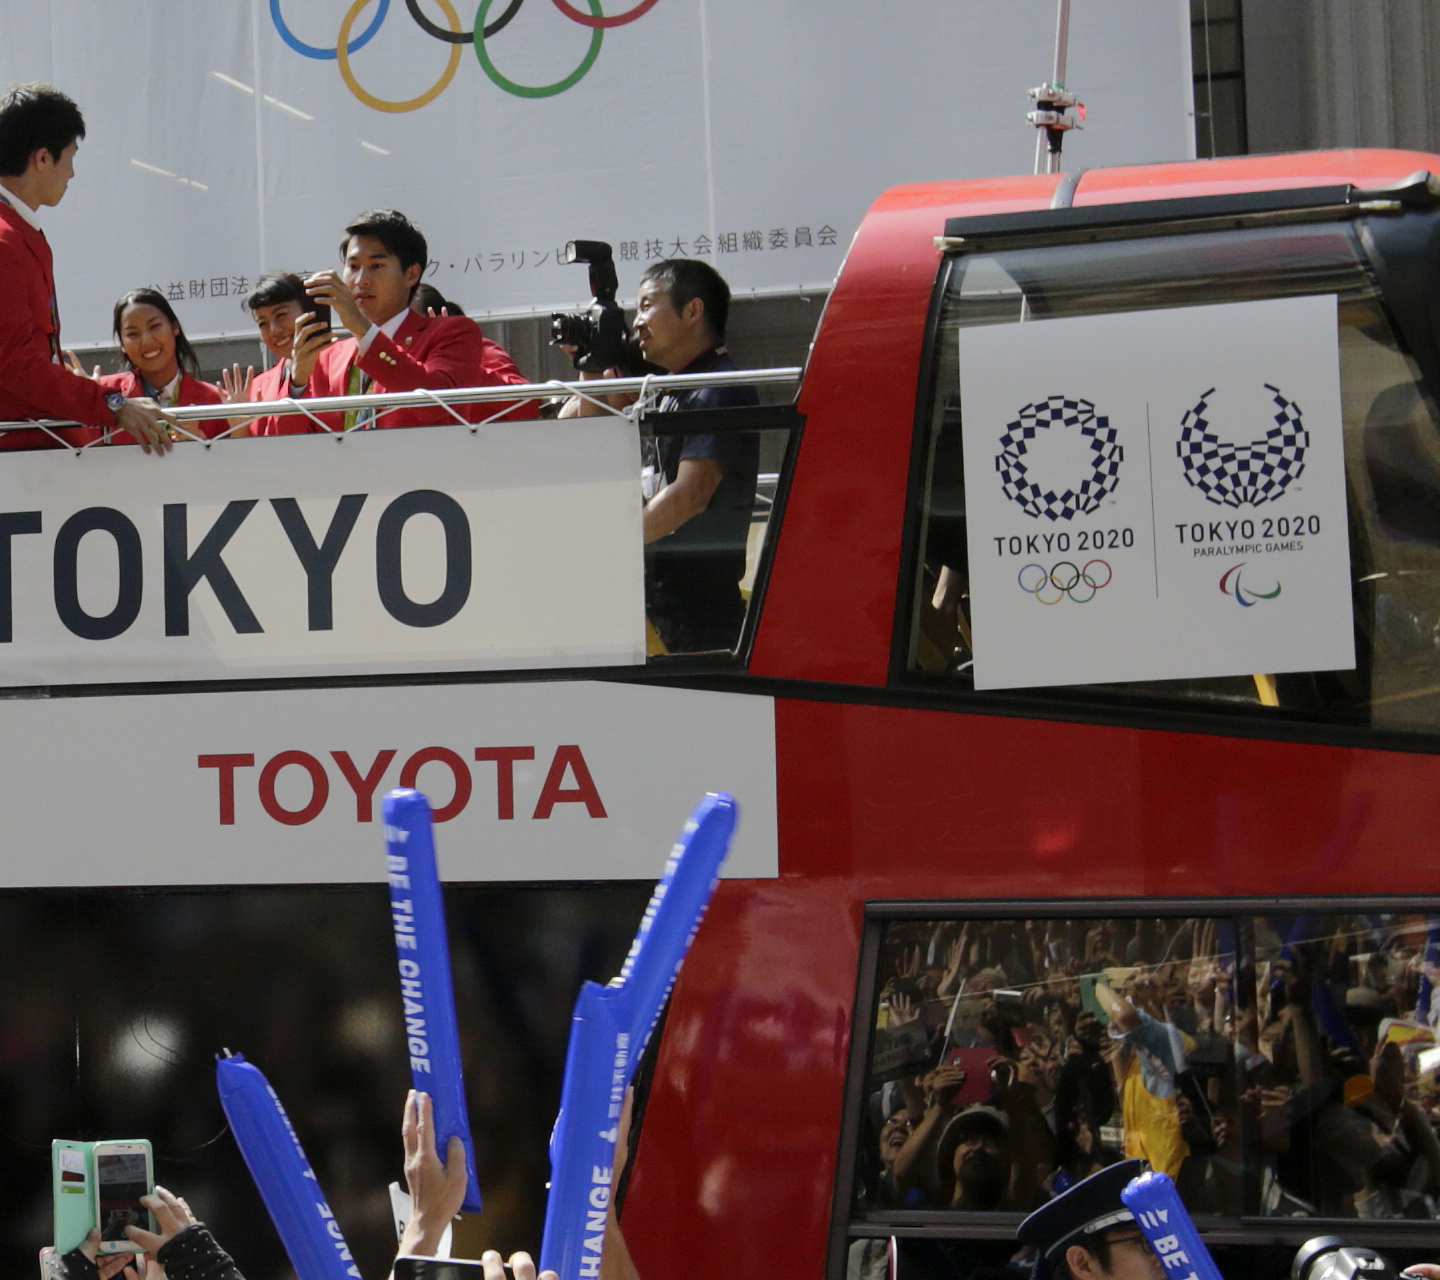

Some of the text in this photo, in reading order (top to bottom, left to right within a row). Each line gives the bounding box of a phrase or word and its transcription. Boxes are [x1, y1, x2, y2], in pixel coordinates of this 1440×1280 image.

[994, 527, 1135, 557] TOKYO 2020
[1175, 515, 1322, 545] TOKYO 2020
[1193, 540, 1304, 558] PARALYMPIC GAMES
[197, 744, 608, 825] TOYOTA
[391, 899, 418, 950] THE
[398, 959, 432, 1074] CHANGE
[1154, 1234, 1190, 1269] BE
